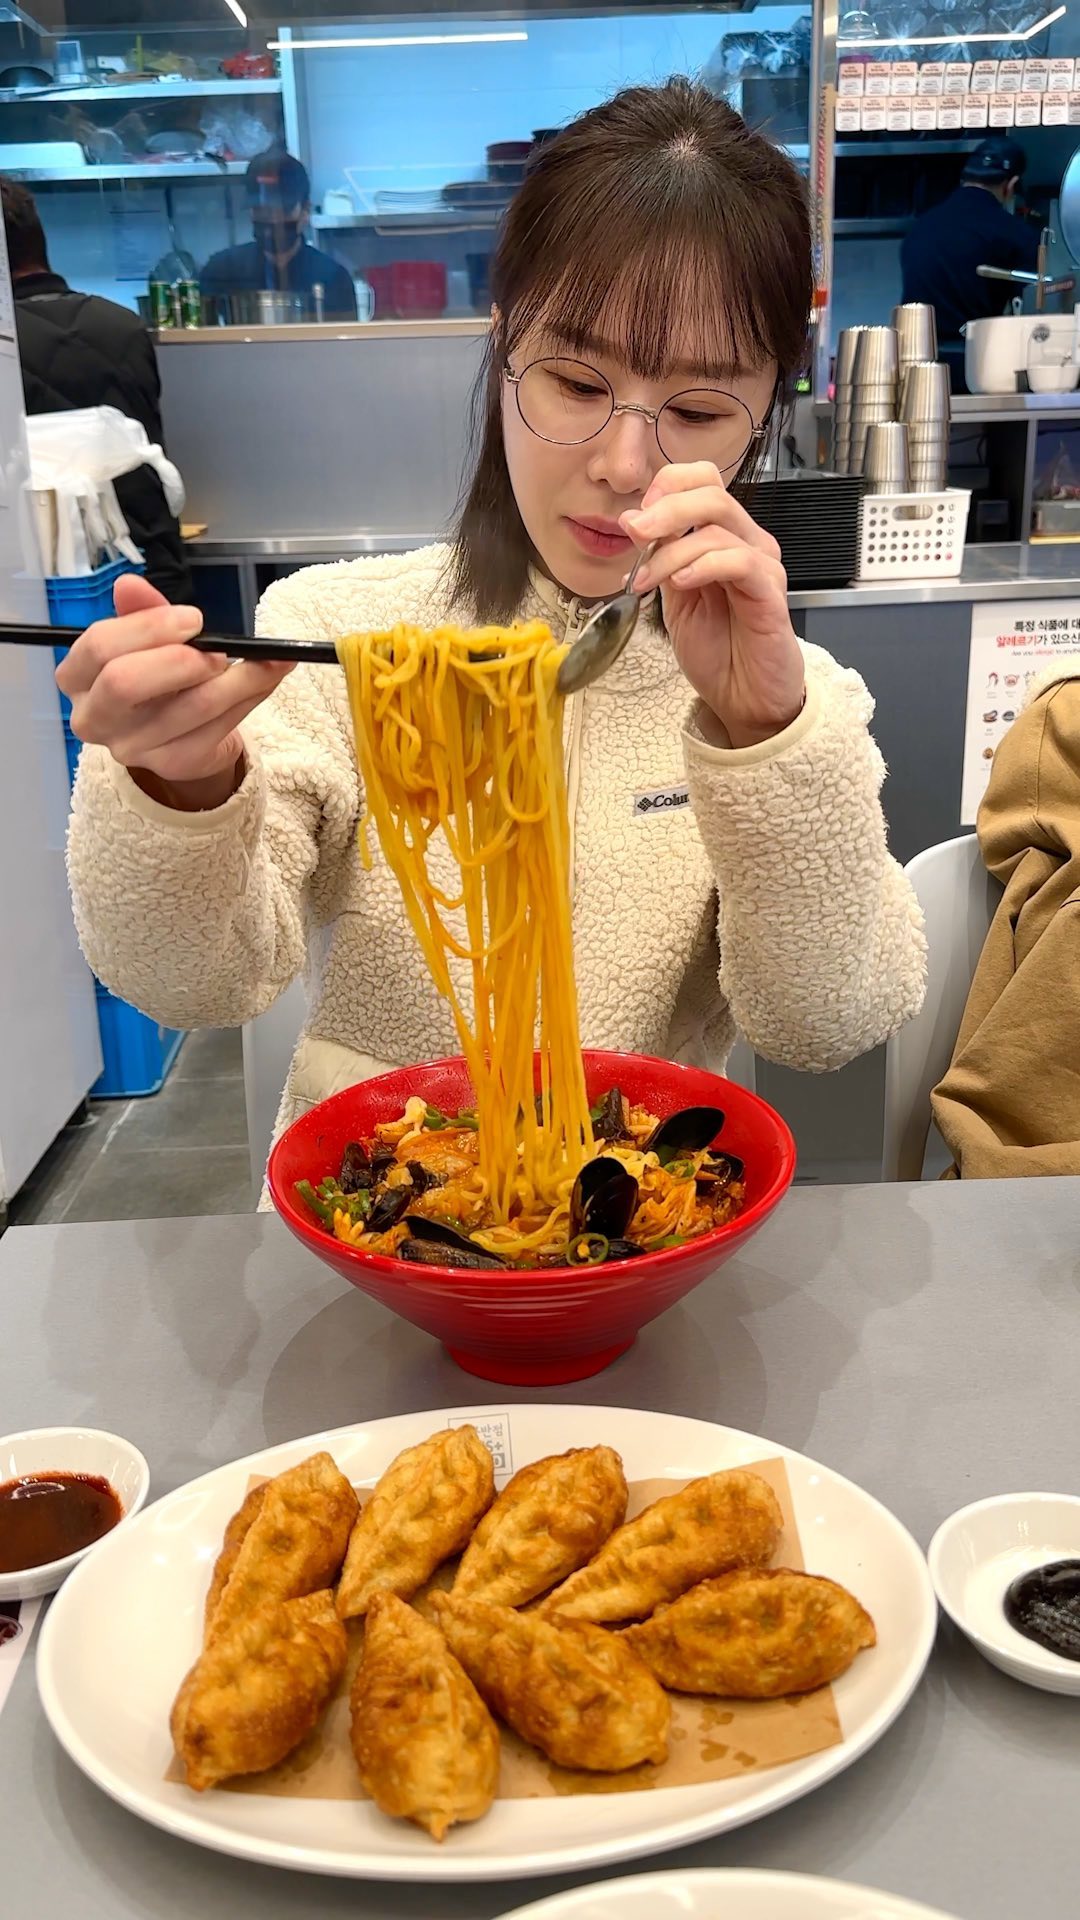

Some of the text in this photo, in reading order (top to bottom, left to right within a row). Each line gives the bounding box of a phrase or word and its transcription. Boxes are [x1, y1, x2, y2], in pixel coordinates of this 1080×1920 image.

[1014, 621, 1035, 632] 특정
[1038, 619, 1068, 631] 식품에
[996, 635, 1048, 647] 알레르기가
[477, 1422, 503, 1437] 반점
